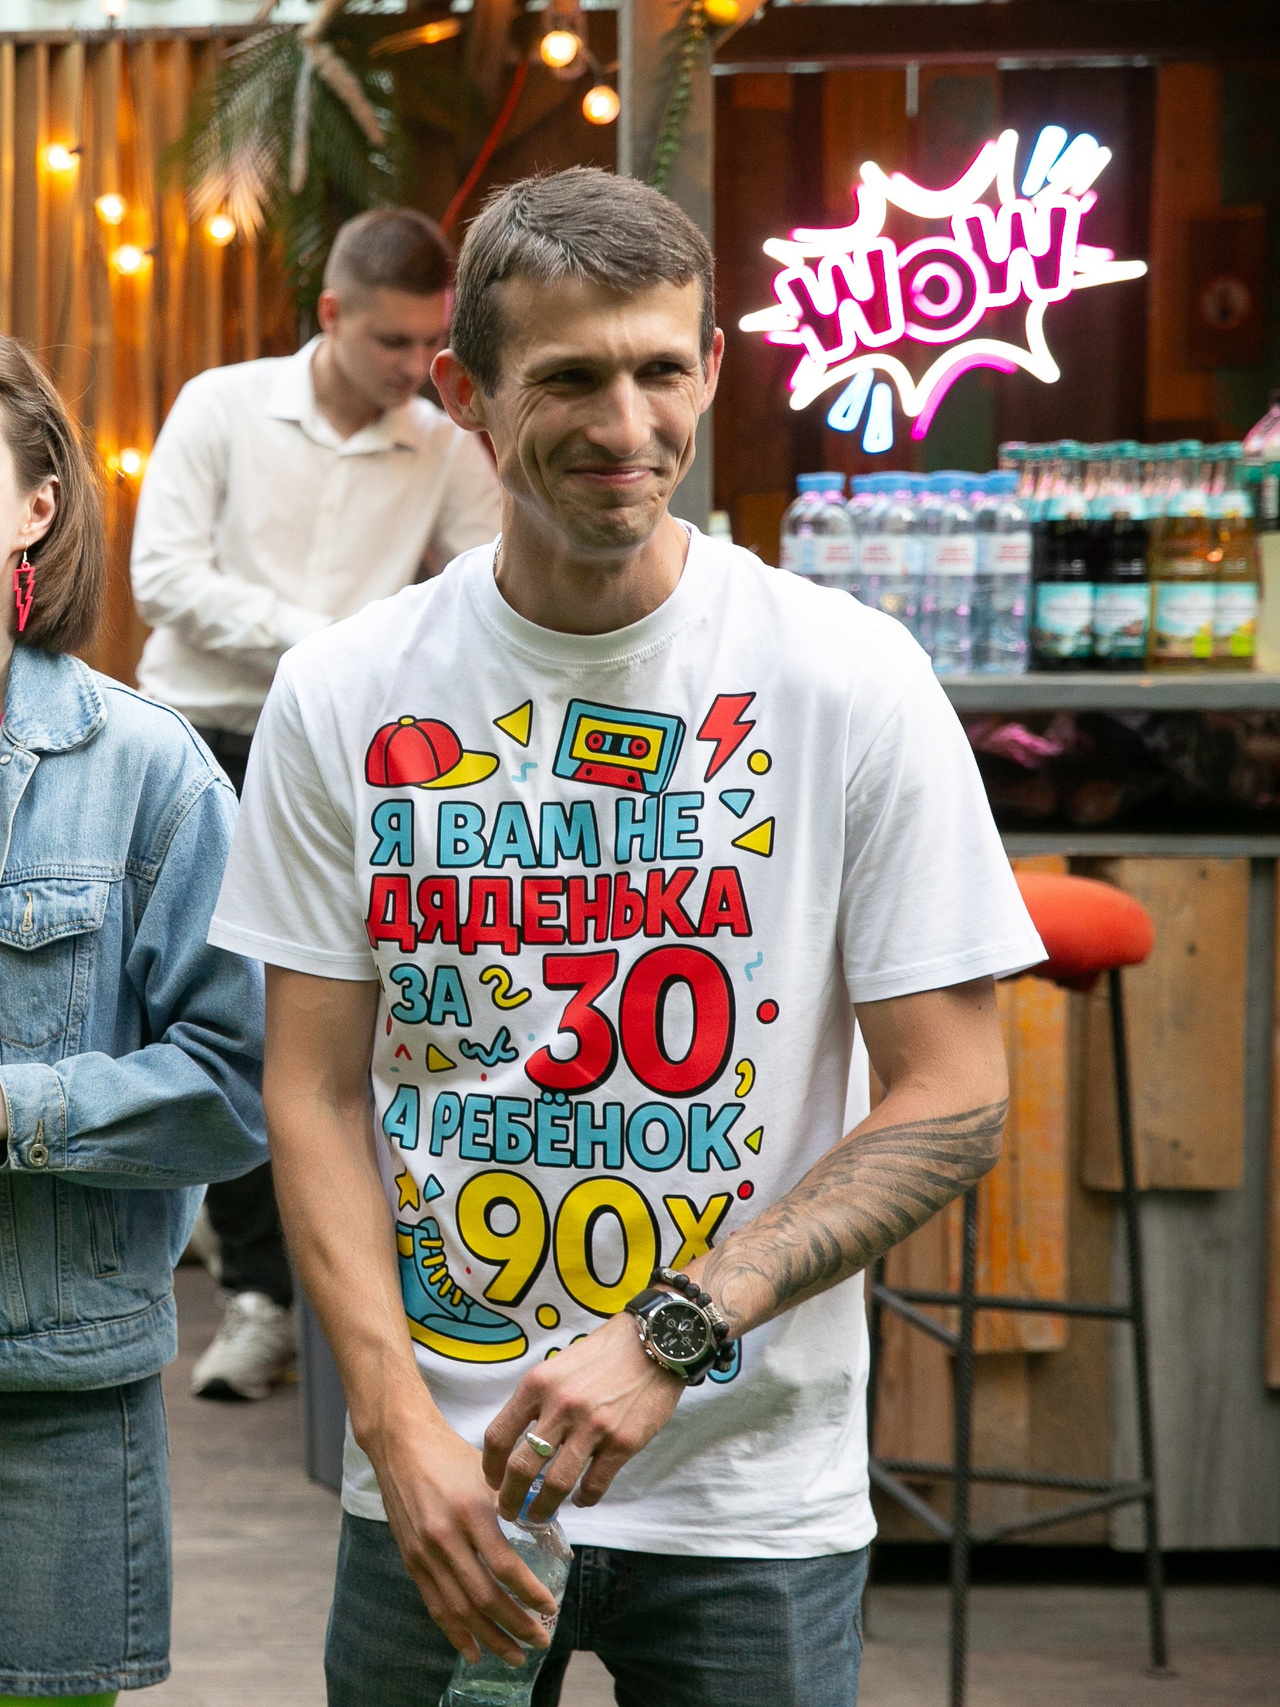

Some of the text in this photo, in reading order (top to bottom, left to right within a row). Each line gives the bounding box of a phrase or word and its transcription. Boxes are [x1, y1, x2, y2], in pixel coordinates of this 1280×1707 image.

[773, 193, 1082, 366] WOW
[369, 791, 705, 868] Я ВАМ НЕ
[365, 866, 753, 956] ДЯДЕНЬКА
[389, 963, 473, 1027] ЗА
[382, 1083, 746, 1173] А РЕБЁНОК
